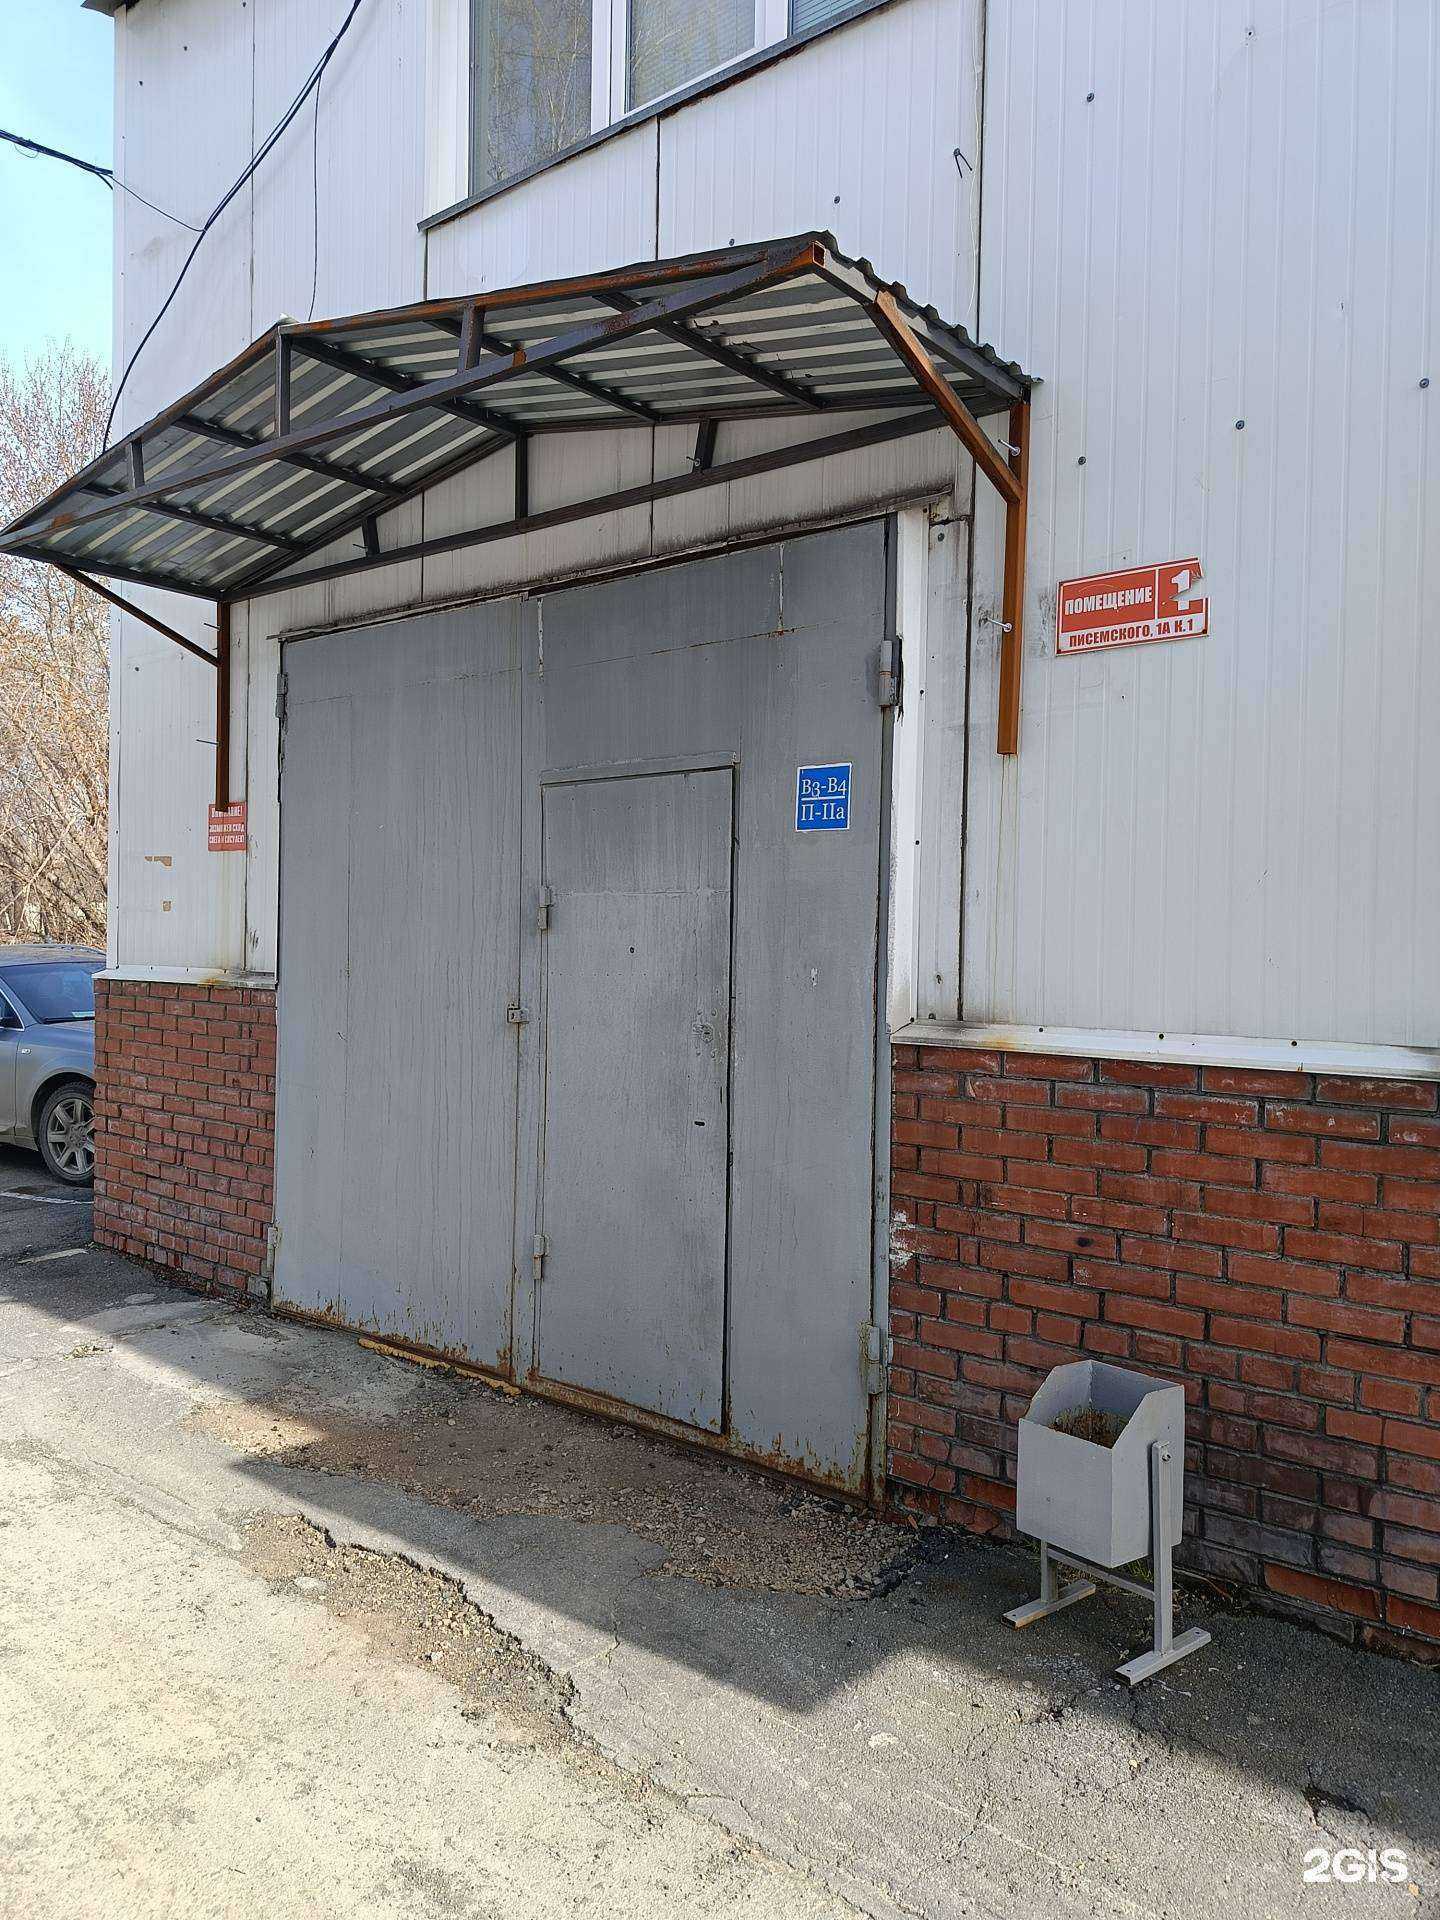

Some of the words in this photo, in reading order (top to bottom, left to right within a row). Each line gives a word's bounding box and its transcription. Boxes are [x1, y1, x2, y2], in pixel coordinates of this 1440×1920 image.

[1065, 586, 1153, 616] ПОМЕЩЕНИЕ
[1171, 569, 1190, 611] 1
[1069, 624, 1153, 648] ПИСЕМСКОГО,
[1156, 621, 1170, 635] 1А
[801, 777, 847, 799] В3-В4
